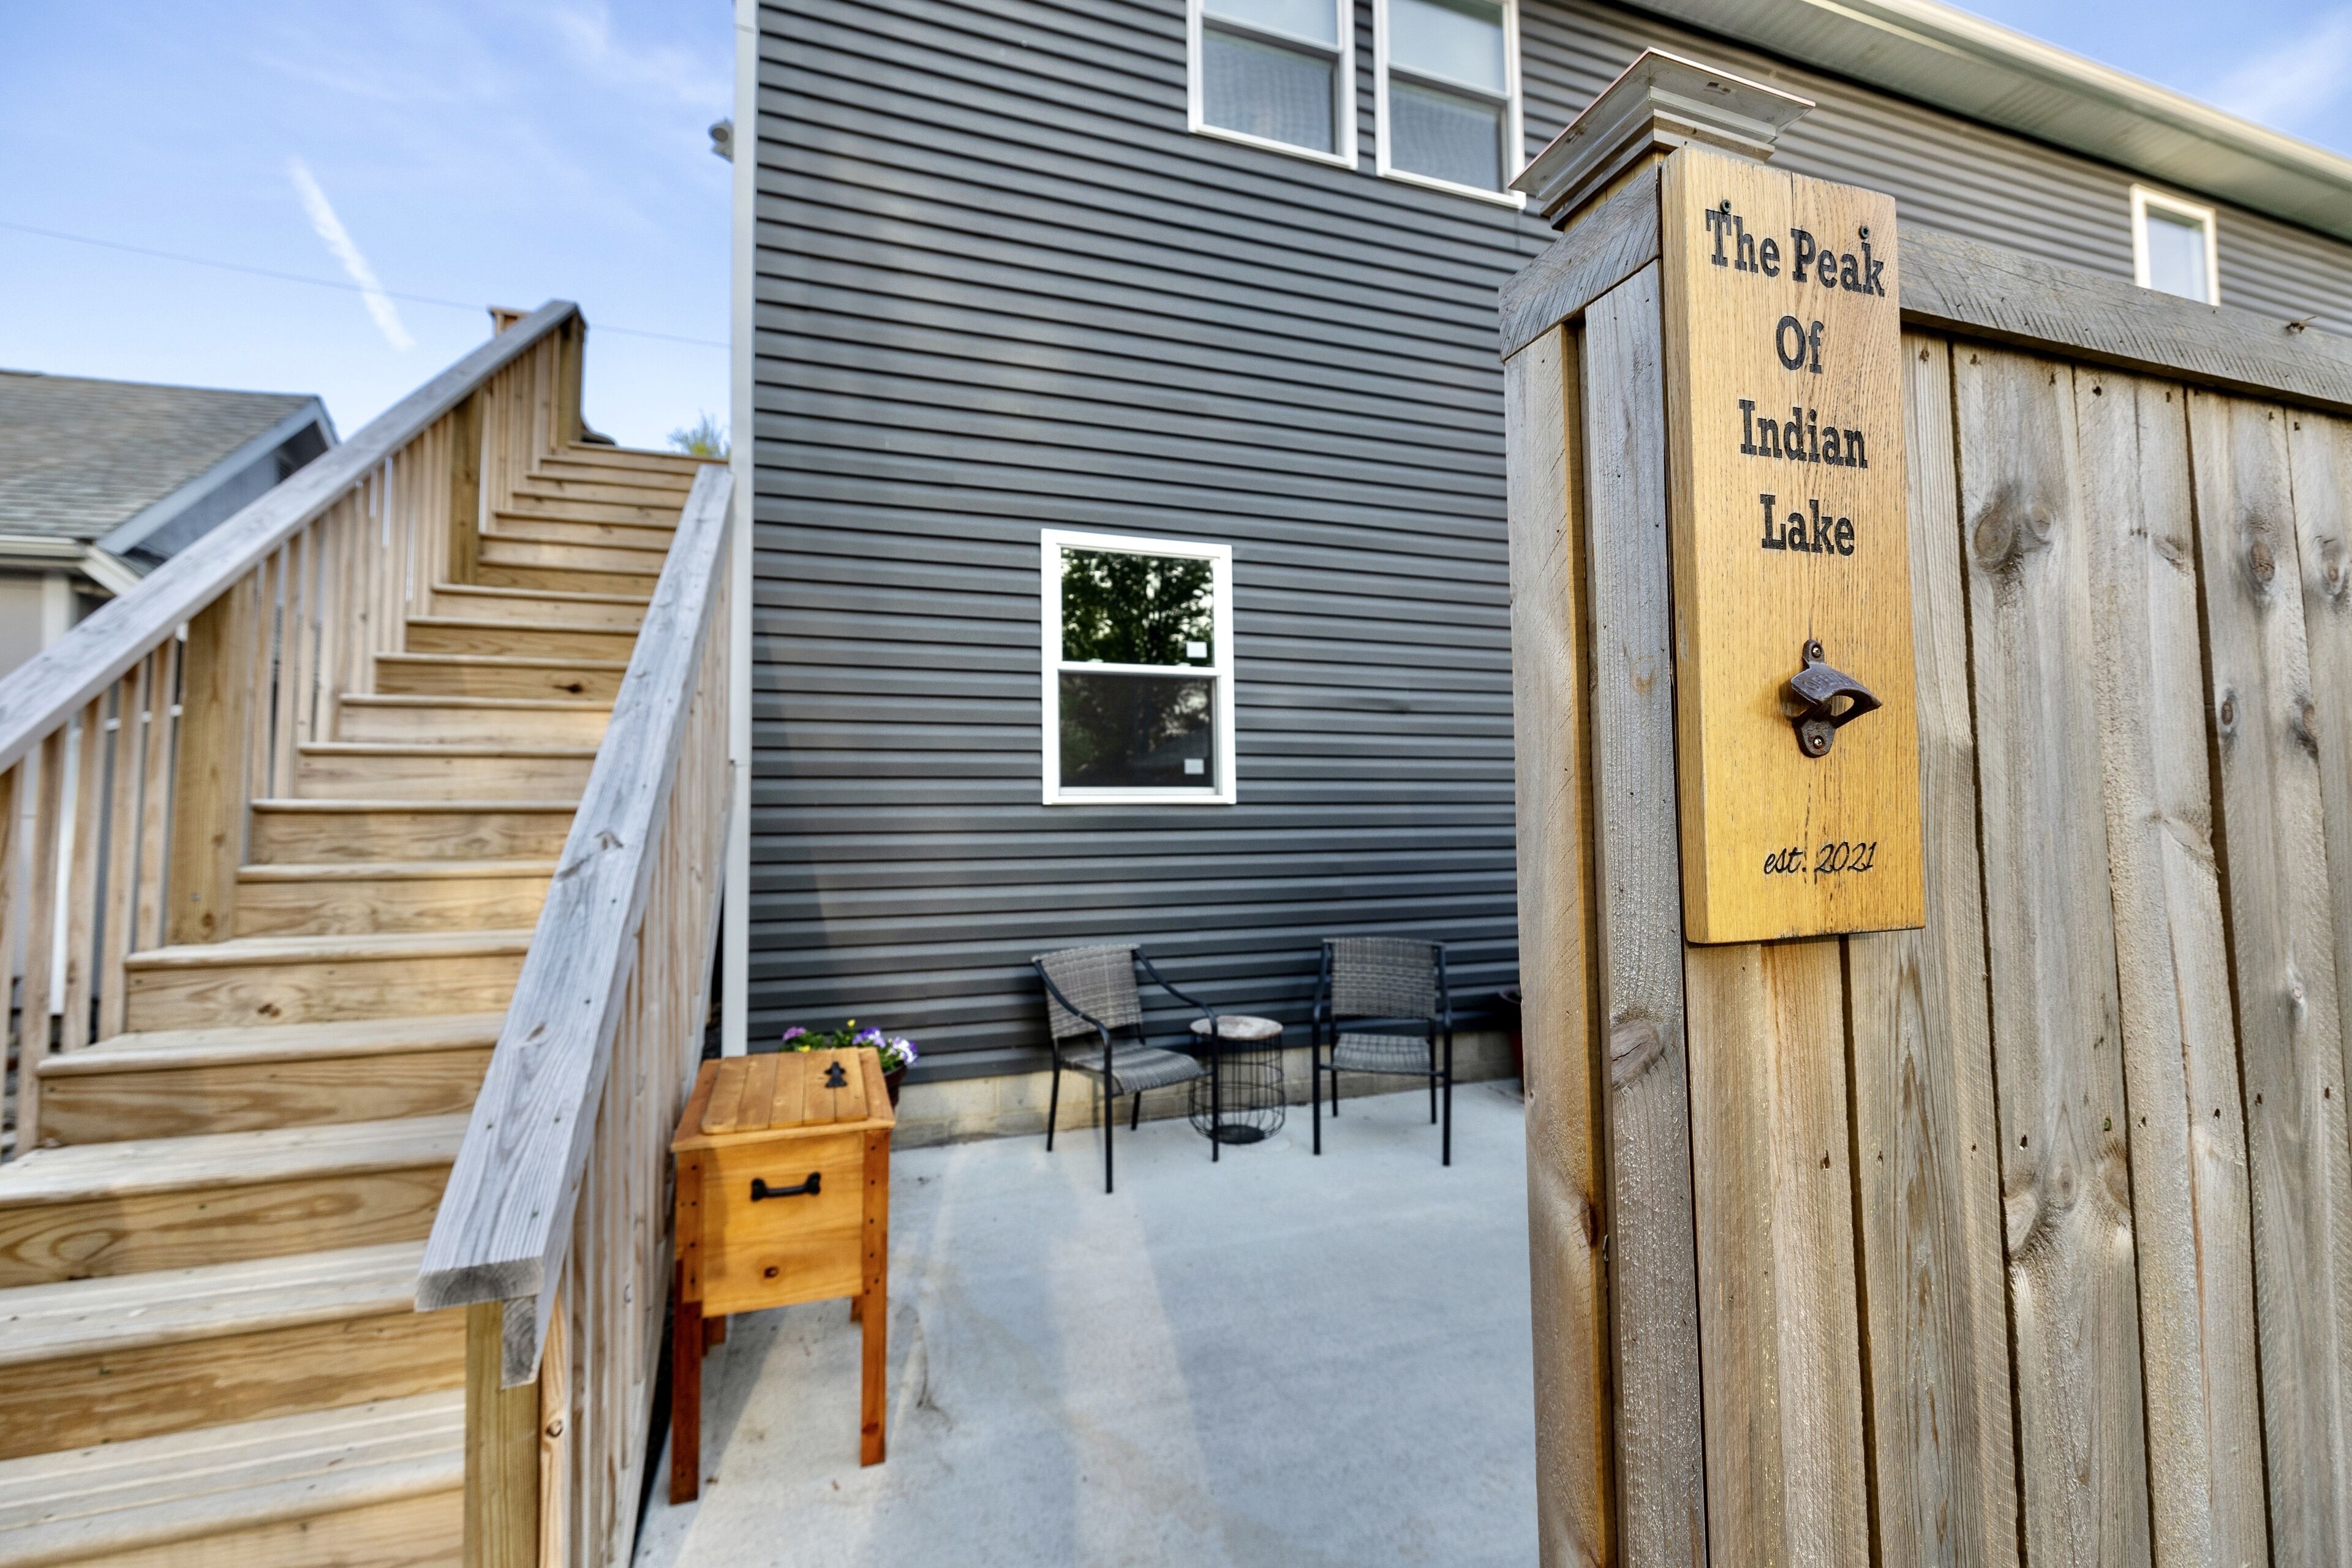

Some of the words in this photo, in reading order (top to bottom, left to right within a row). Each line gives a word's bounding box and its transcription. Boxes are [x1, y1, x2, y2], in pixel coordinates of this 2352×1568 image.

[1705, 208, 1780, 277] The
[1790, 228, 1885, 297] Peak
[1776, 315, 1824, 374] Of
[1739, 399, 1868, 469] Indian
[1760, 494, 1855, 556] Lake
[1763, 846, 1806, 875] est.
[1814, 842, 1877, 874] 2021
